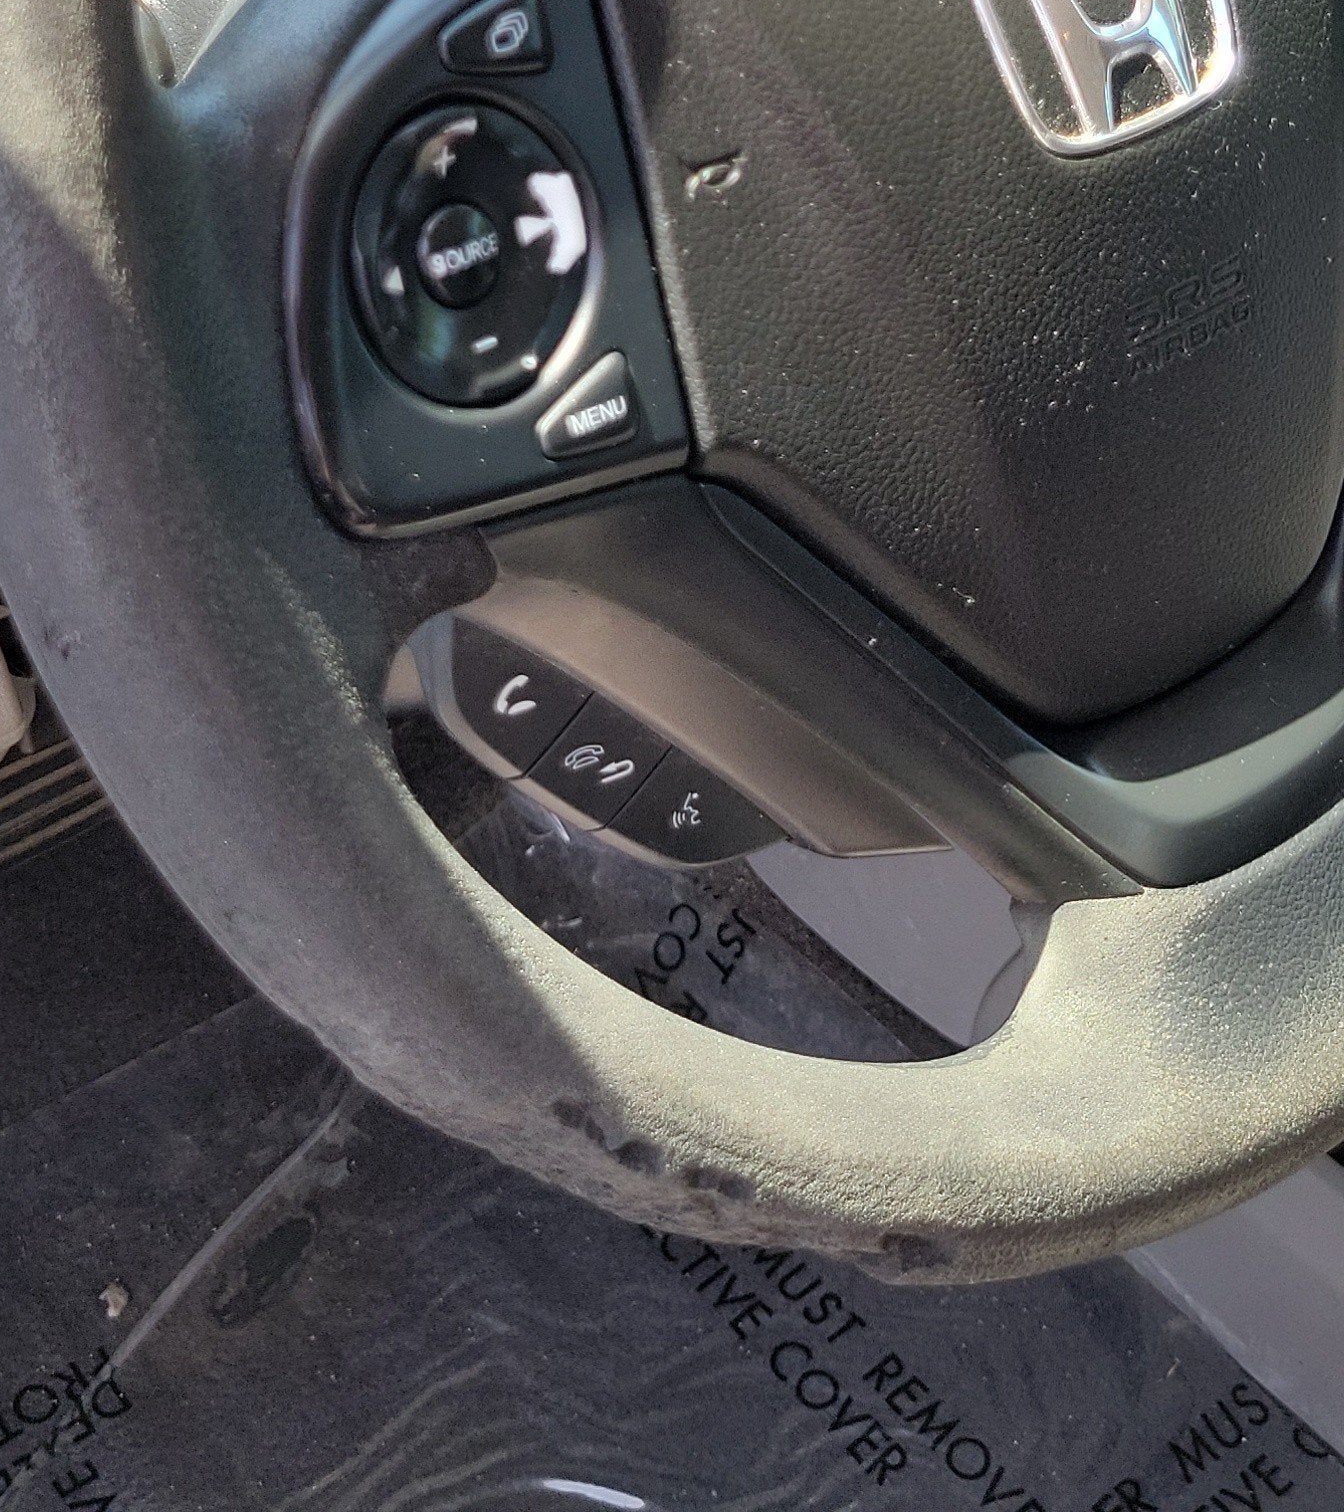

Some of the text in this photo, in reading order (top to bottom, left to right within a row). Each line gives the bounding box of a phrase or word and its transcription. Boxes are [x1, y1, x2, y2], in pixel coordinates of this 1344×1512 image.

[430, 233, 499, 277] SOURCE
[567, 395, 628, 437] MENU
[746, 1244, 866, 1343] MUST
[769, 1340, 907, 1486] COVER
